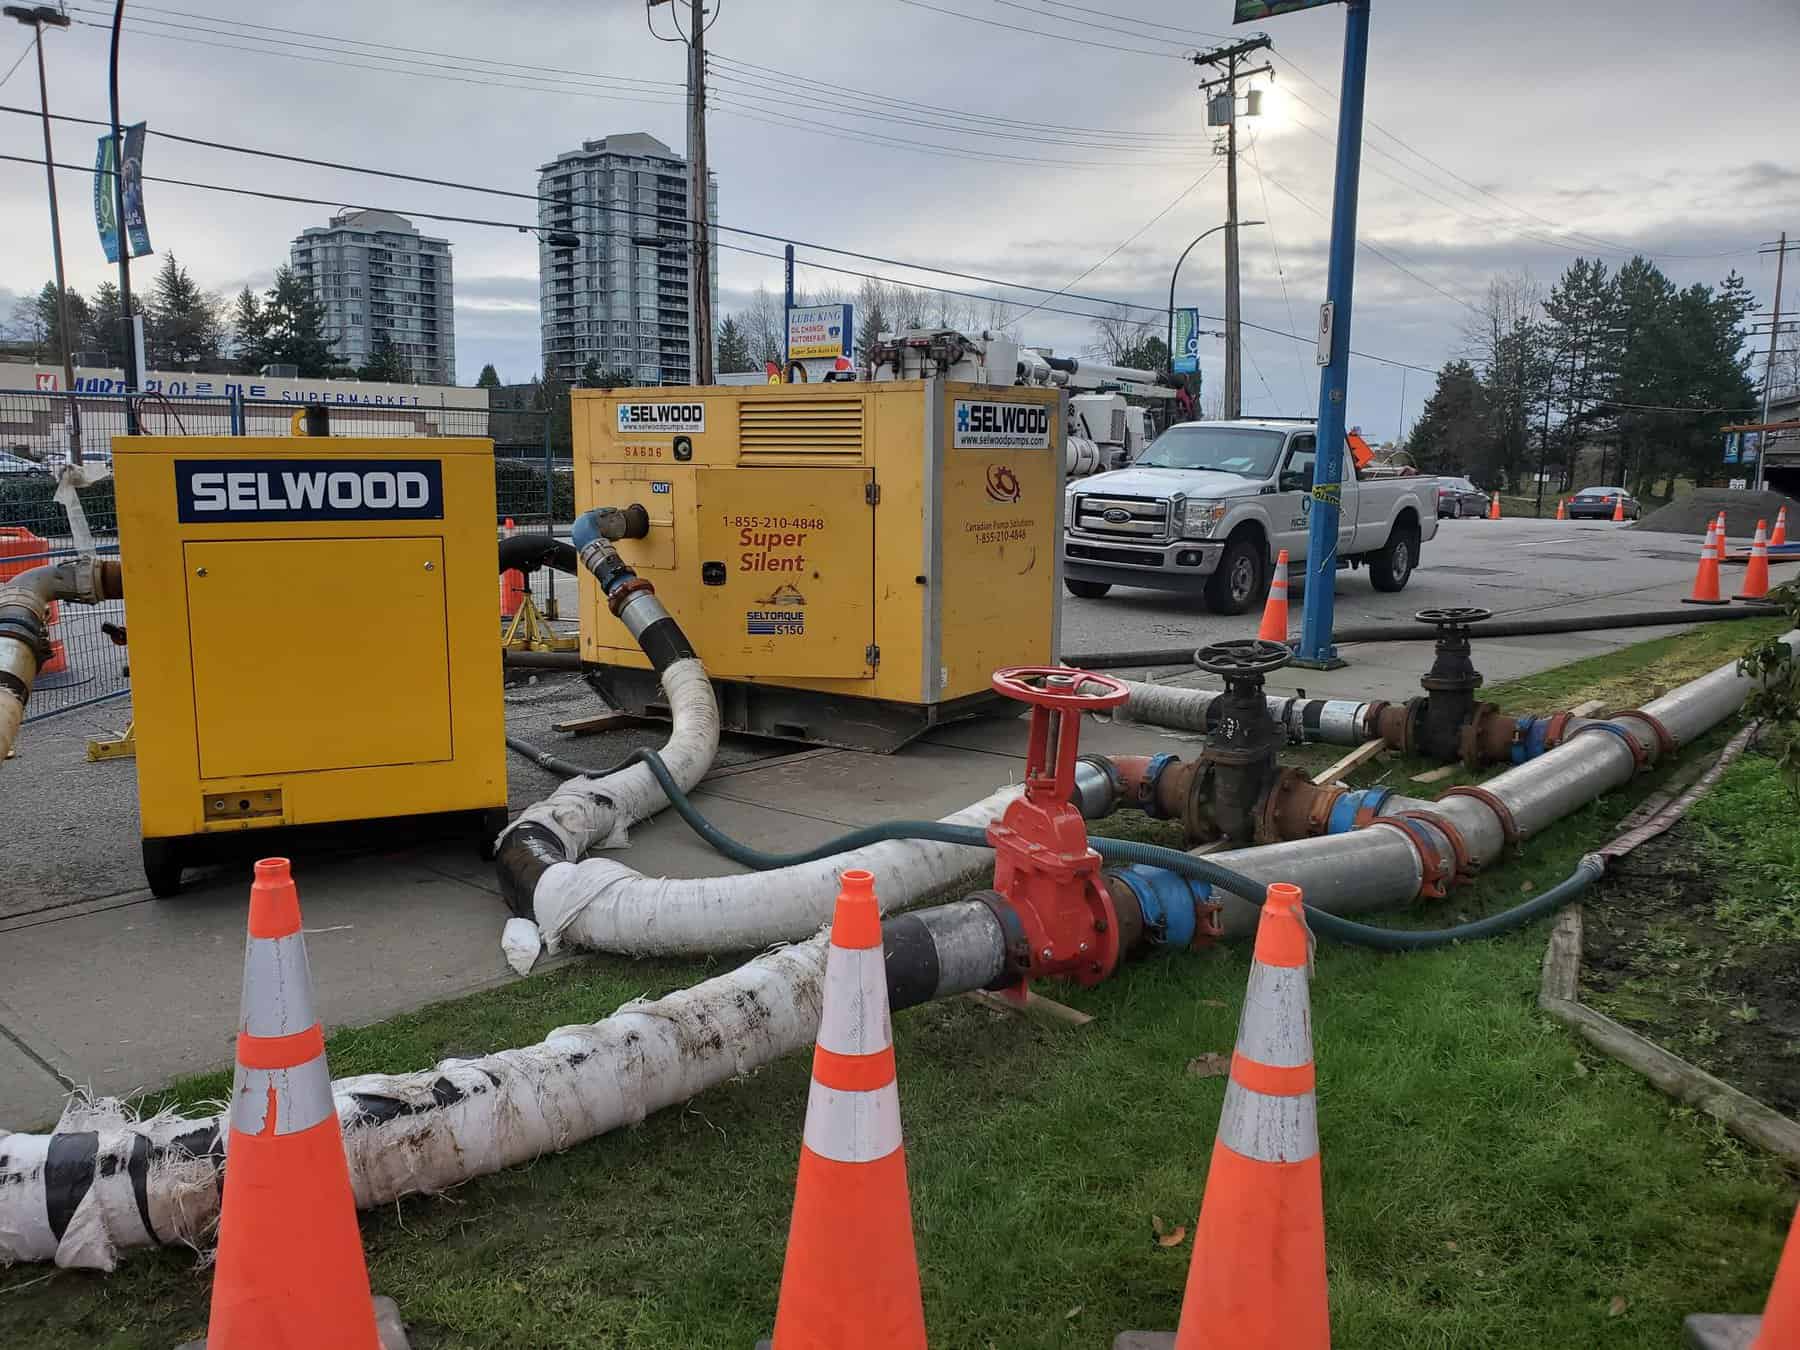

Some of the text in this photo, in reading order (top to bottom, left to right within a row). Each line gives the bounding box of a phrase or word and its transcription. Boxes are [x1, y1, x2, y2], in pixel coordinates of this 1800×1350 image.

[282, 391, 419, 406] SUPERMARKET
[630, 406, 702, 422] SELWOOD
[970, 405, 1048, 434] SELWOOD
[961, 435, 1044, 446] www.selwoodpumps.com
[192, 472, 430, 511] SELWOOD
[653, 484, 669, 492] OUT
[723, 516, 824, 529] 1-855-210-4848
[739, 528, 807, 552] Super
[740, 552, 805, 571] Silent
[747, 612, 804, 620] SELTORQUE
[776, 626, 804, 635] S150
